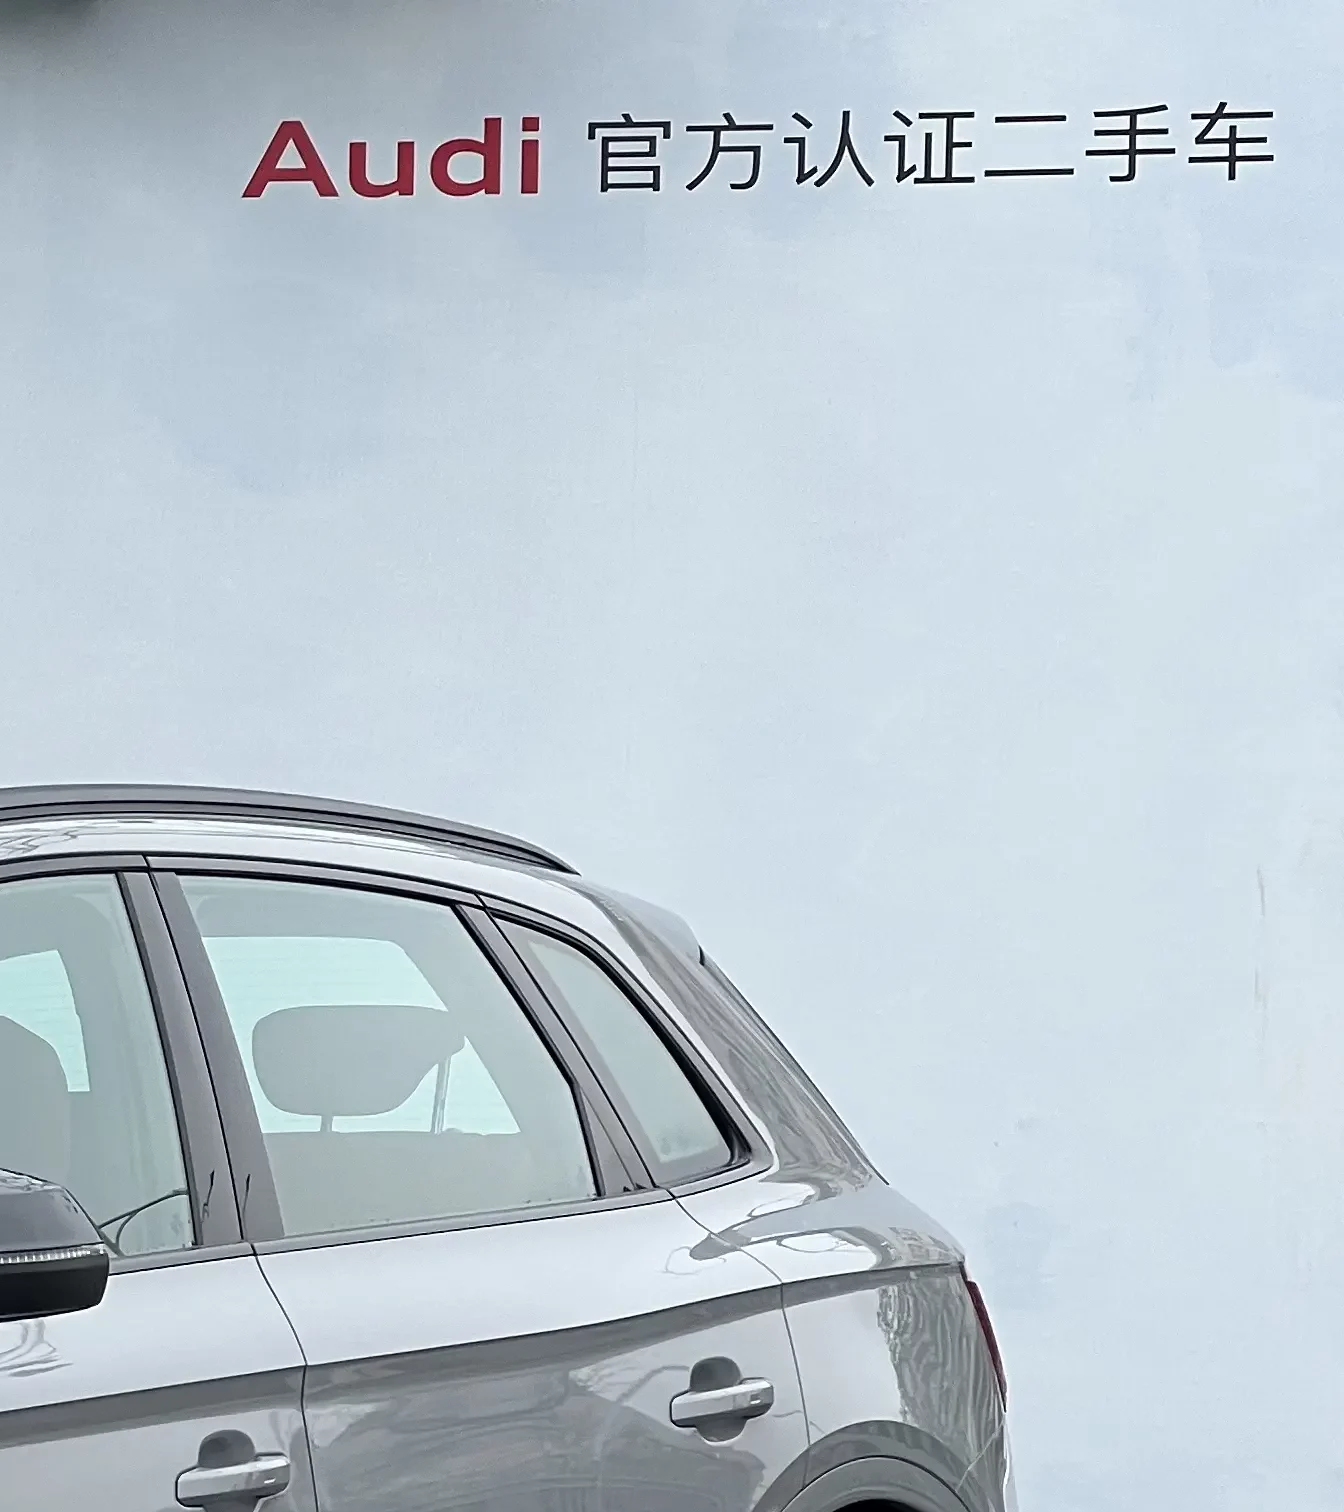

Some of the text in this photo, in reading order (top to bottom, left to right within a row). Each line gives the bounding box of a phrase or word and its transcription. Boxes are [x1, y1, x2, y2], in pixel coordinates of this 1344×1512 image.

[242, 101, 1276, 199] Audi 官方认证二手车
